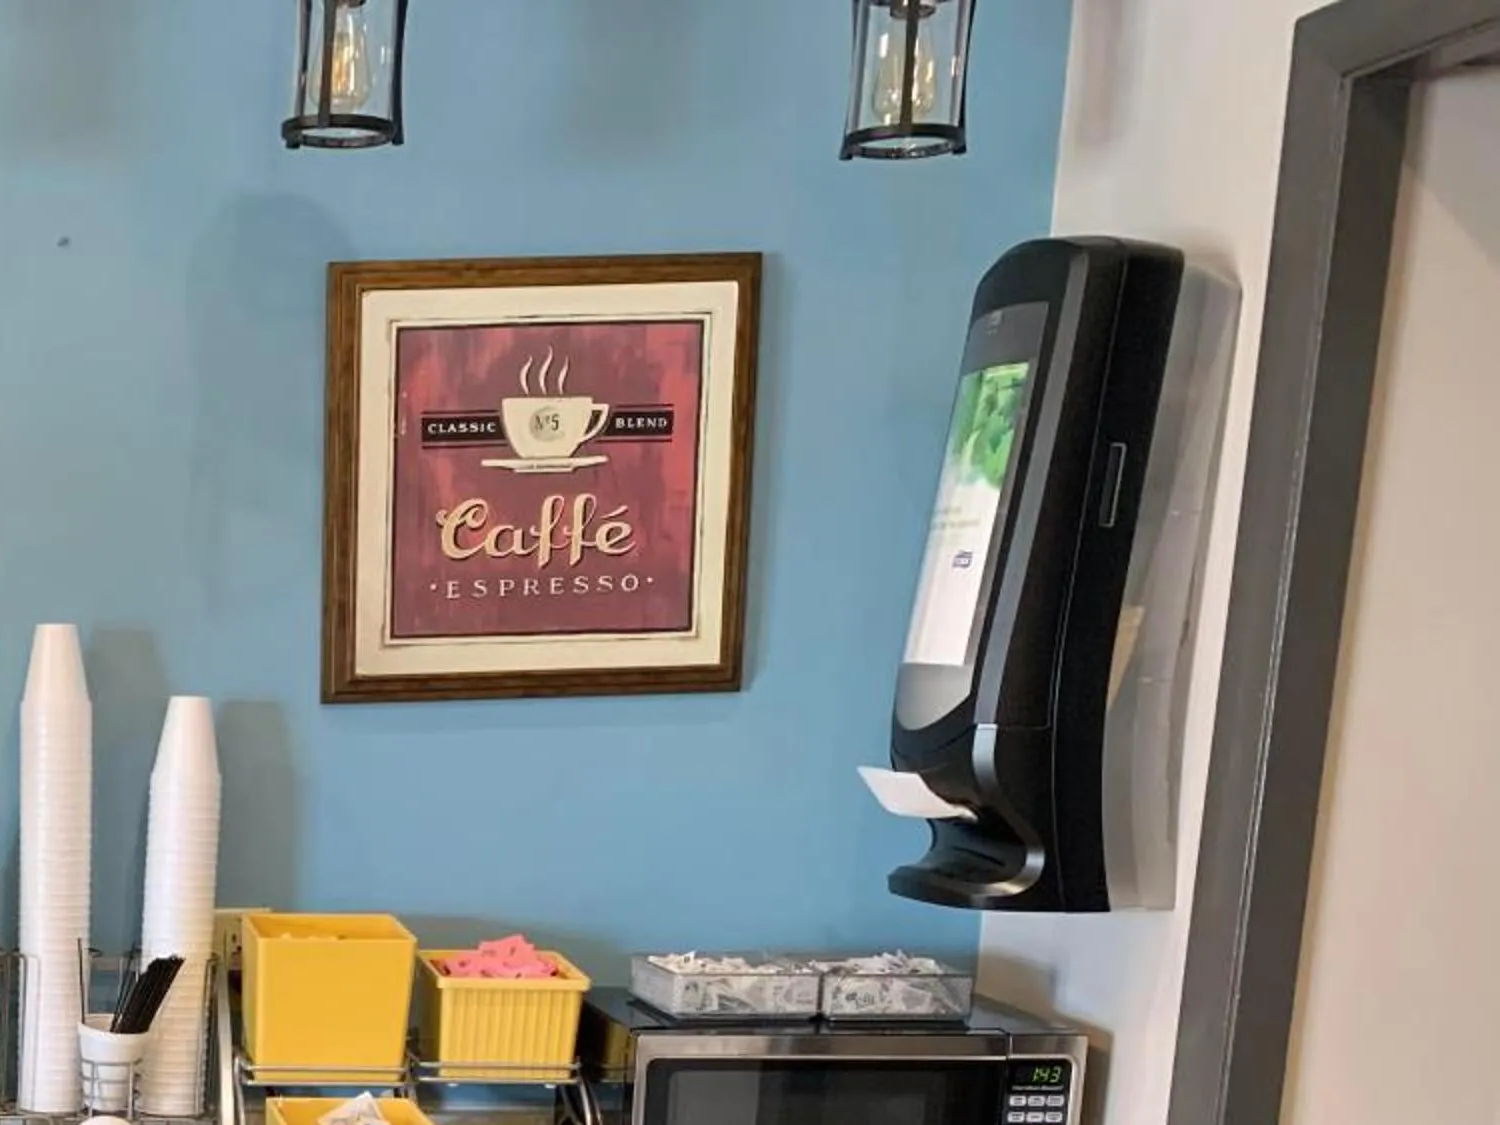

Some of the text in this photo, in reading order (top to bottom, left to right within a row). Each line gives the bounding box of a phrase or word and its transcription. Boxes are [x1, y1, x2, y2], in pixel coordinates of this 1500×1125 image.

[427, 416, 668, 434] CLASSIC BLEND
[435, 493, 636, 568] Caffé
[446, 574, 640, 599] ESPRESSO
